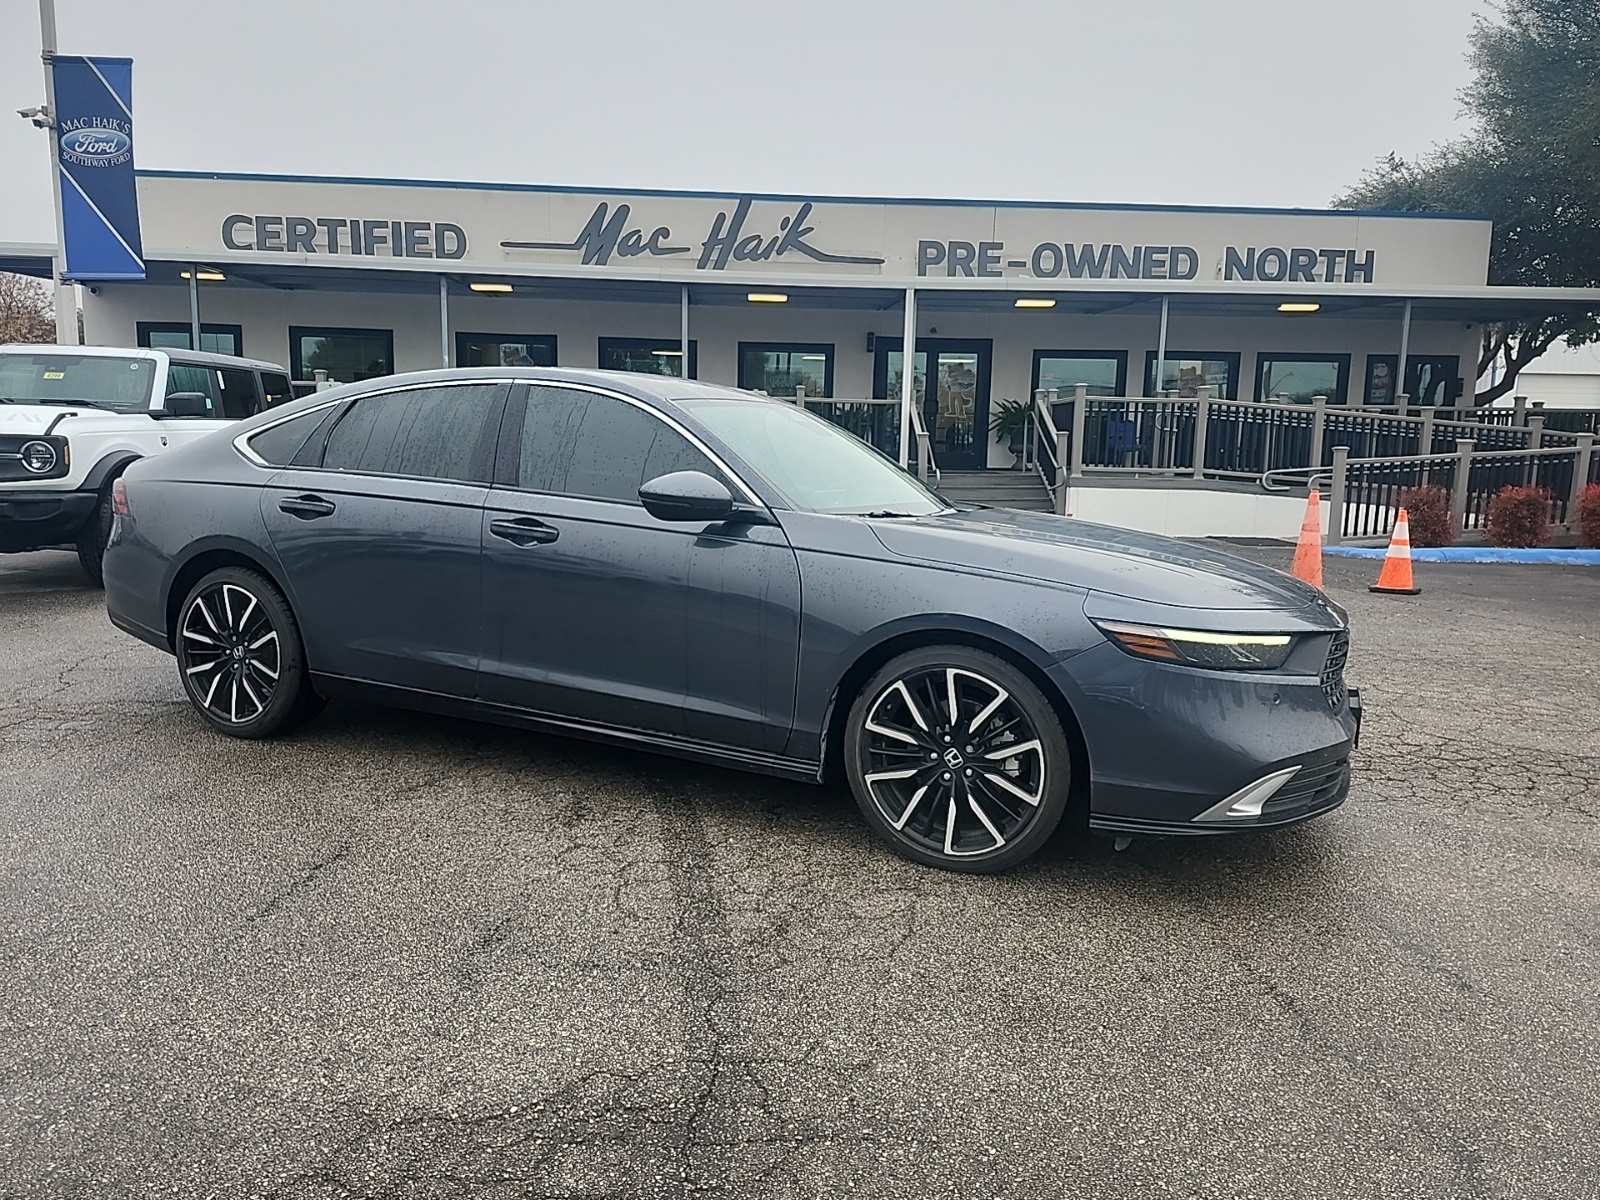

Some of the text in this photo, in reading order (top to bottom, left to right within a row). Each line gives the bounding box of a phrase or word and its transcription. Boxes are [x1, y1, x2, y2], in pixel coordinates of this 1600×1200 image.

[61, 117, 131, 134] MAC HAIK'S
[74, 133, 118, 153] Ford
[62, 152, 131, 167] SOUTHWAY FORD
[222, 214, 467, 260] CERTIFIED
[500, 195, 886, 270] Mac Haik
[917, 240, 1376, 284] PRE-OWNED NORTH
